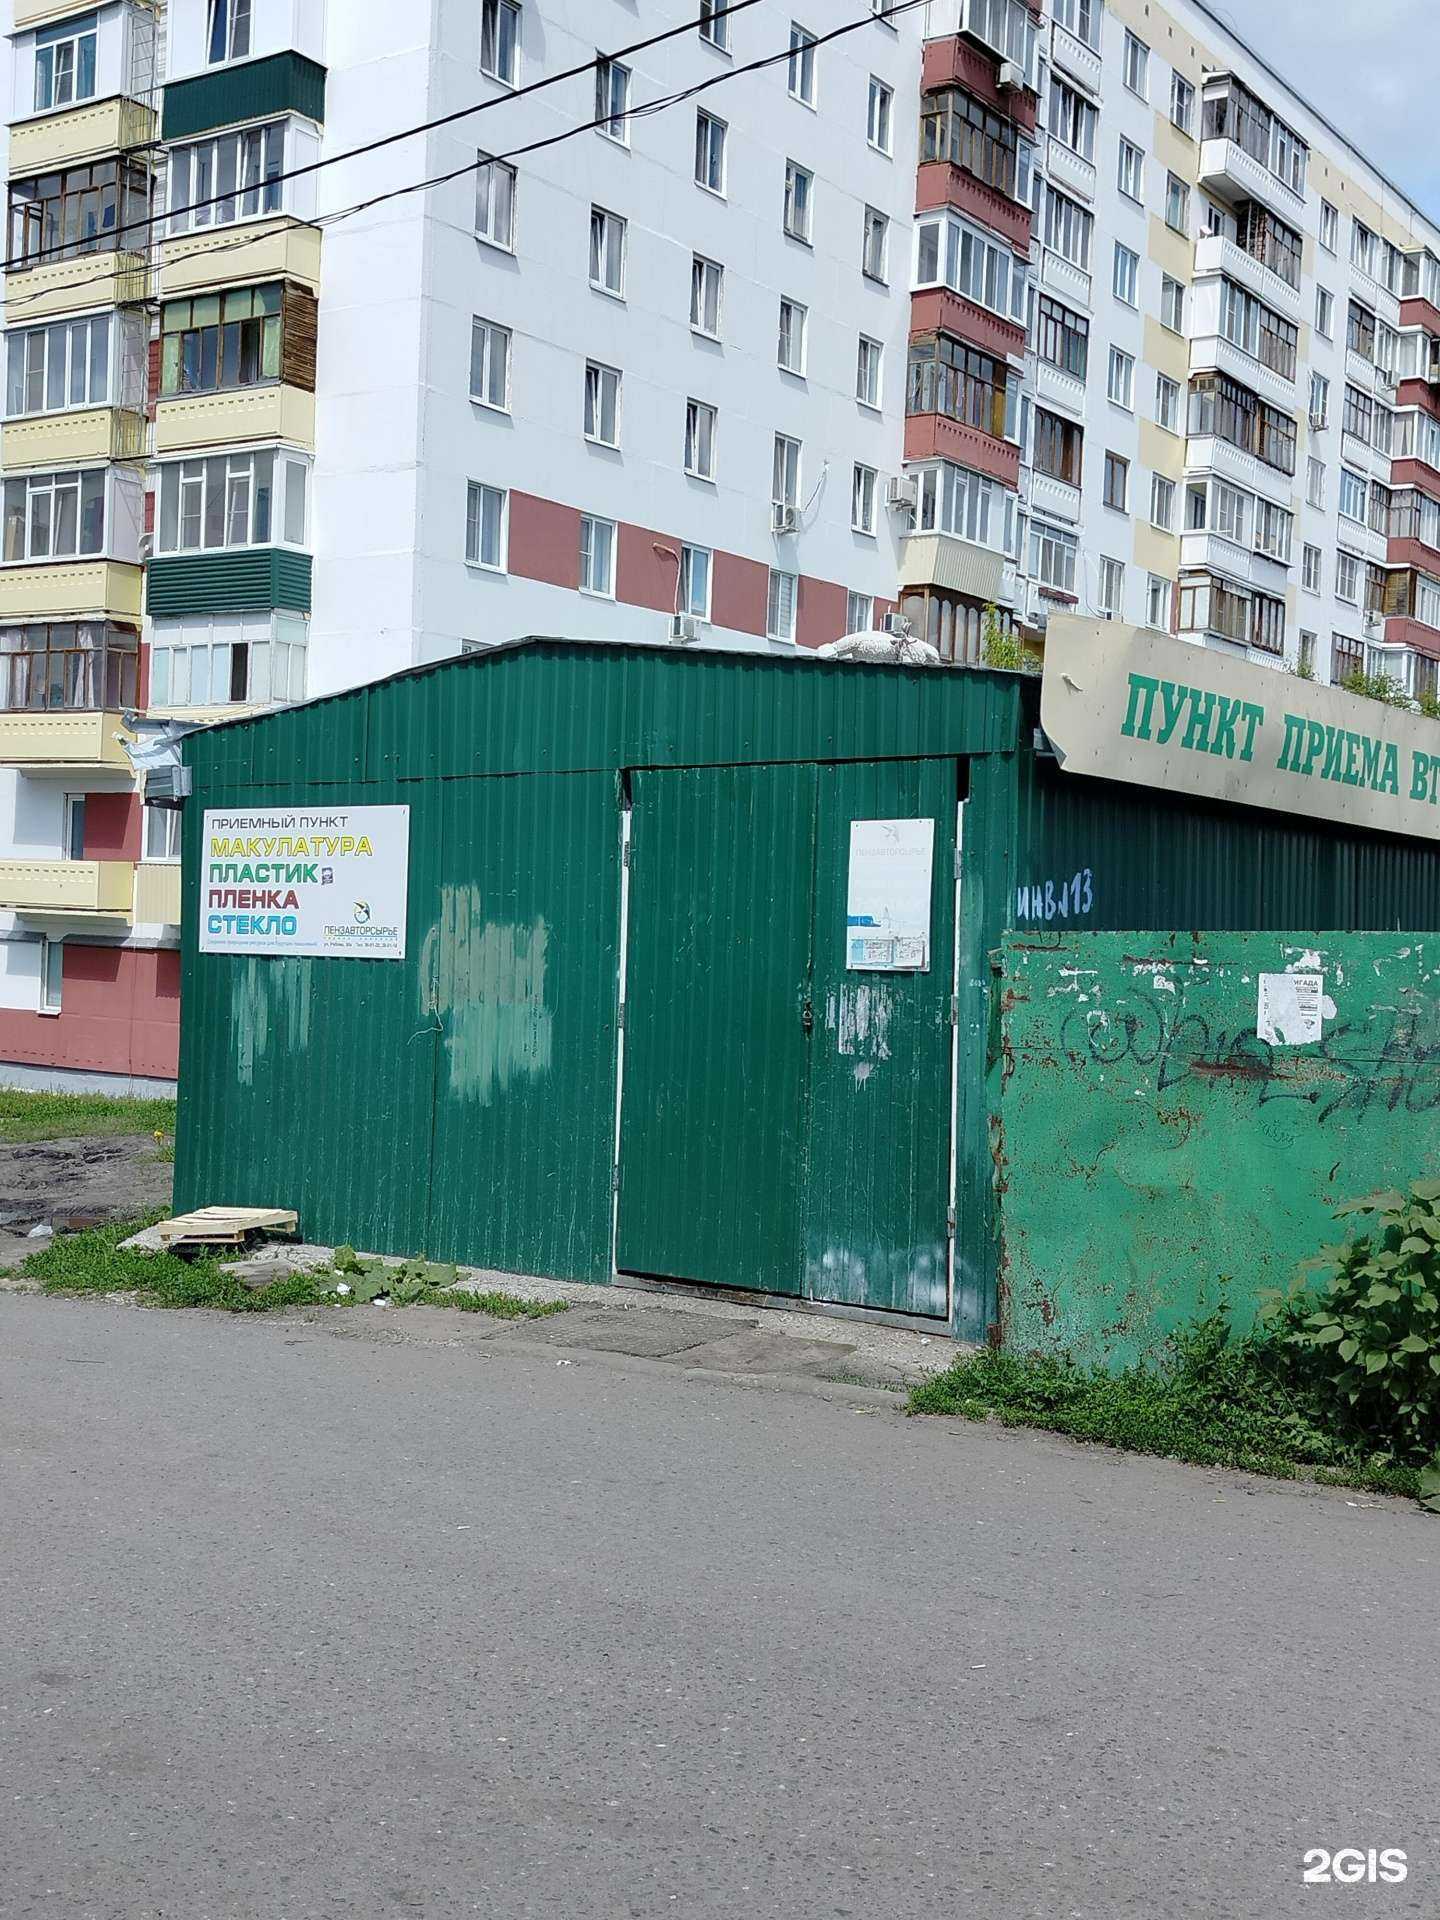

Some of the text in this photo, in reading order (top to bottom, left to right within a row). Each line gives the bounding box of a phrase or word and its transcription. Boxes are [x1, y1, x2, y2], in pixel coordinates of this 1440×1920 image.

[1120, 672, 1265, 762] ПУНКТ
[1276, 713, 1399, 796] ПРИЕМА
[211, 814, 349, 830] ПРИЕМНЫЙ ПУНКТ
[210, 836, 373, 858] МАКУЛАТУРА
[208, 863, 319, 884] ПЛАСТИК
[208, 889, 300, 910] ПЛЕНКА
[207, 915, 297, 936] СТЕКЛО
[323, 925, 399, 936] ПЕНЗАВТОРСЫРЬЕ
